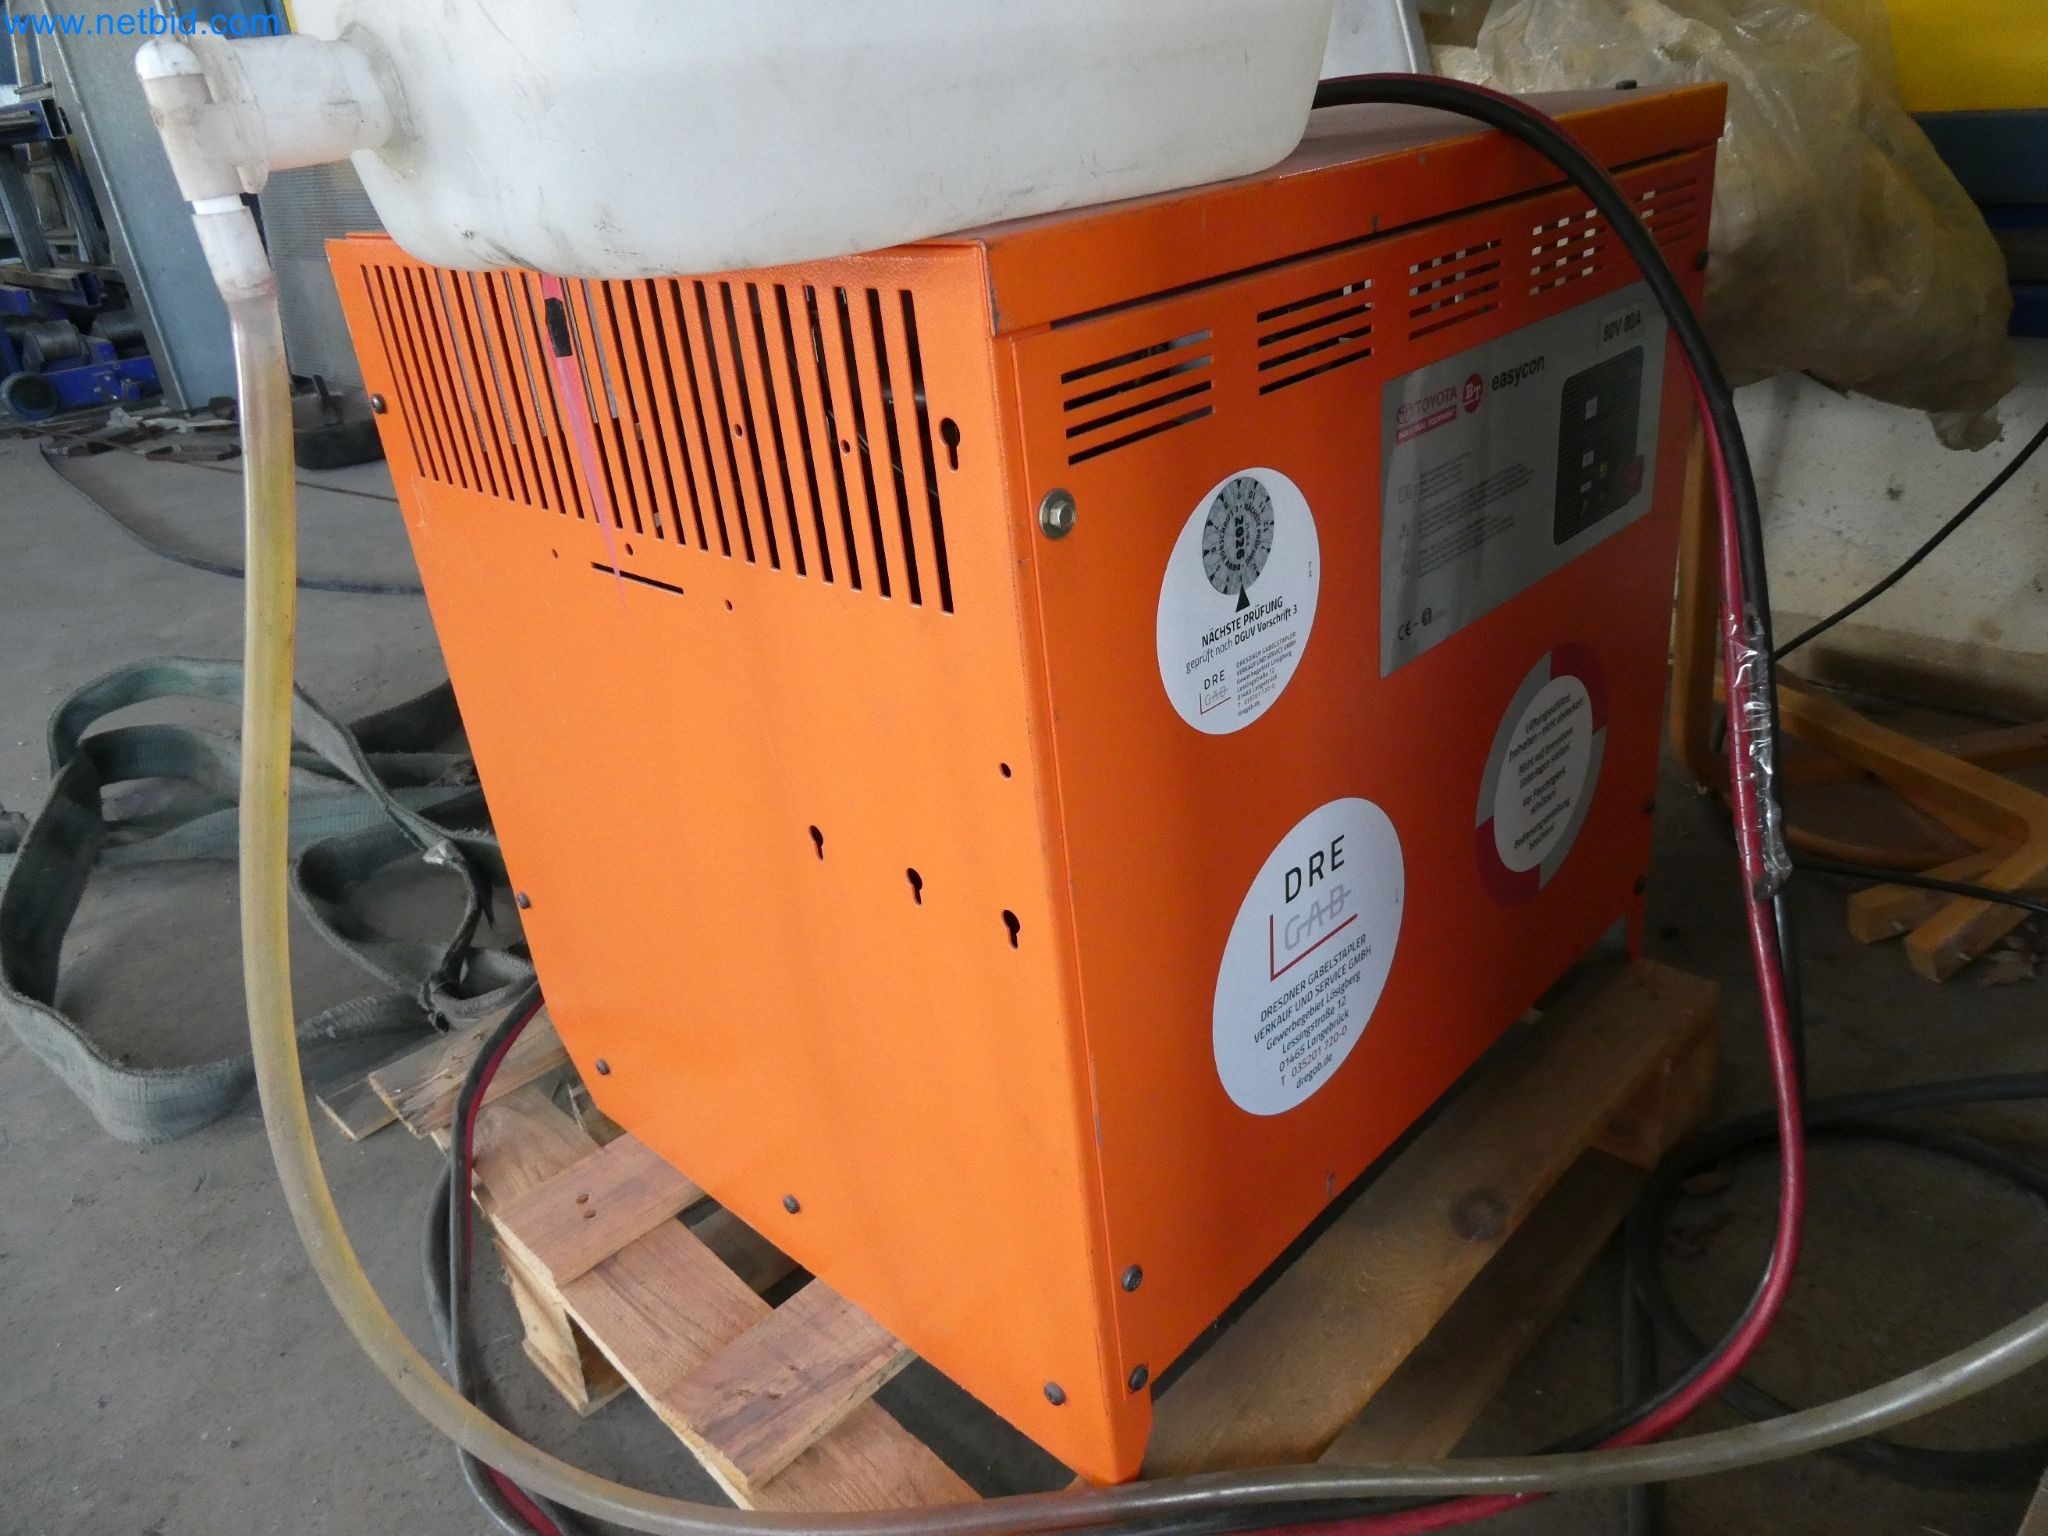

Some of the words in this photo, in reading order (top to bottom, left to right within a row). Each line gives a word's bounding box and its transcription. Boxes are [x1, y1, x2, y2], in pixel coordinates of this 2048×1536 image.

[1415, 386, 1458, 417] TOYOTA
[1491, 355, 1545, 391] easycon
[1234, 515, 1245, 560] 2026
[1186, 648, 1214, 675] geprüft
[1215, 638, 1233, 657] nach
[1234, 625, 1256, 645] DGUV
[1257, 607, 1292, 633] Vorschrift
[1293, 604, 1298, 615] 3
[1201, 617, 1241, 647] NÄCHSTE
[1243, 596, 1283, 626] PRÜFUNG
[1203, 669, 1225, 690] DRE
[1285, 834, 1345, 904] DRE
[1284, 884, 1351, 951] GAB
[1253, 1005, 1293, 1044] VERKAUF
[1294, 990, 1313, 1012] UND
[1314, 965, 1346, 996] SERVICE
[1347, 944, 1372, 970] GMBH
[1260, 979, 1306, 1022] DRESDNER
[1307, 933, 1367, 985] GABELSTAPLER
[1266, 998, 1325, 1050] Gewerbegebiet
[1279, 1047, 1305, 1072] 01465
[1307, 1009, 1350, 1049] Langebrück
[1282, 1006, 1335, 1054] Lessingstraße
[1337, 996, 1347, 1009] 12
[1281, 1074, 1286, 1086] T
[1291, 1048, 1321, 1077] 035201
[1325, 1025, 1348, 1050] 720-0
[1296, 1053, 1333, 1089] dregab.de
